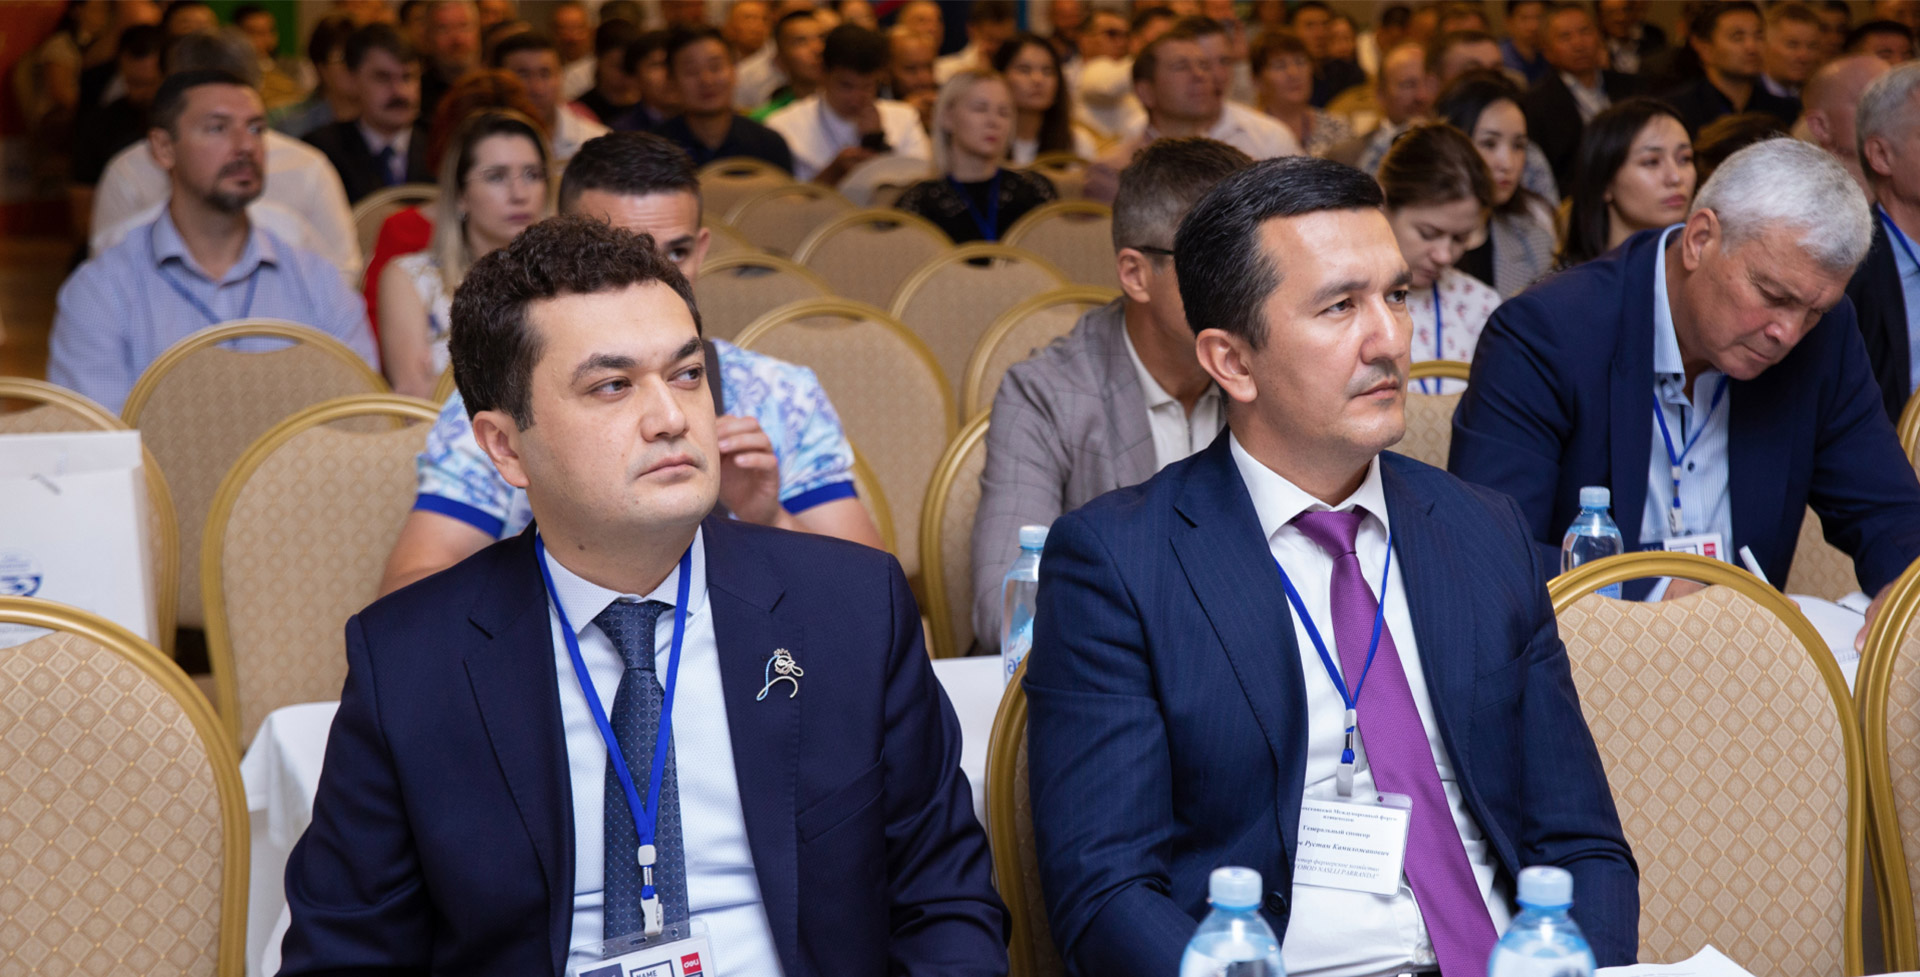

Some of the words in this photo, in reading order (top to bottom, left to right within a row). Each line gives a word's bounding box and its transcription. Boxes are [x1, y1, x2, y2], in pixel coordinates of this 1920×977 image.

[1302, 824, 1344, 835] Генеральный
[1345, 830, 1370, 839] спонсор
[1304, 839, 1330, 849] Рустам
[684, 959, 699, 968] deli
